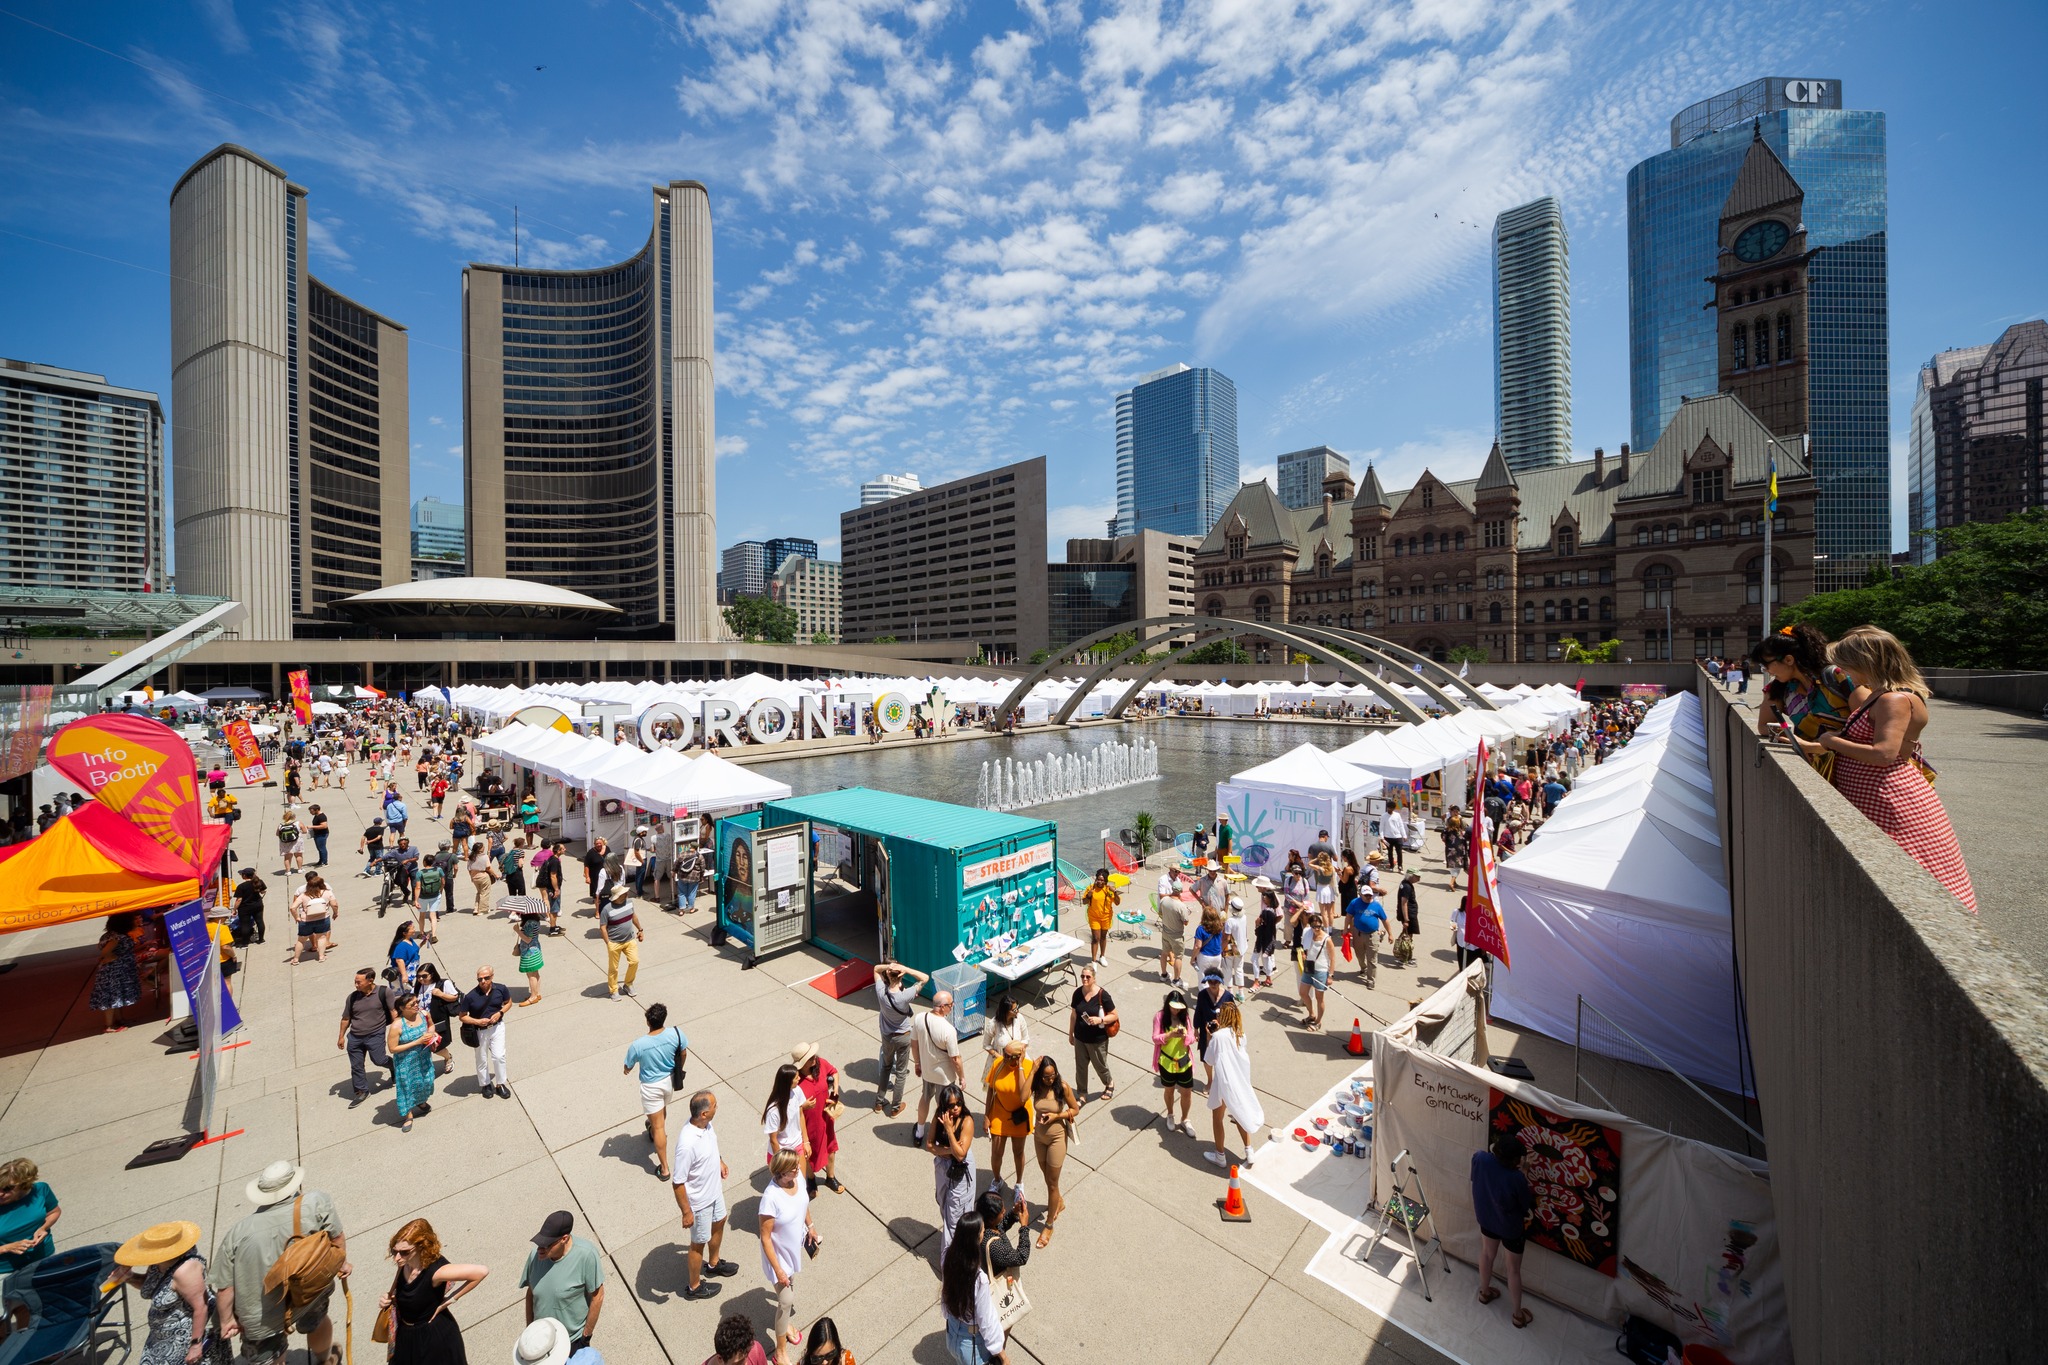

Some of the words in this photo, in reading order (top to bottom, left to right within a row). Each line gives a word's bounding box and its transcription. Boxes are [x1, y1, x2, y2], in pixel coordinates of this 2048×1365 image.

[1785, 80, 1826, 103] CF
[582, 691, 911, 752] TORONTO
[234, 725, 247, 739] Art
[242, 739, 257, 759] Nest
[82, 747, 127, 767] Info
[89, 760, 158, 787] Booth
[1273, 799, 1324, 827] innit
[980, 857, 1017, 878] STREET
[1018, 850, 1035, 867] ART
[3, 908, 64, 925] Outdoor
[68, 904, 90, 915] Art
[95, 900, 120, 910] Fair
[1477, 916, 1501, 937] Out
[1477, 929, 1495, 946] Art
[1414, 1072, 1436, 1093] Erin
[1000, 1299, 1025, 1322] ATCHING
